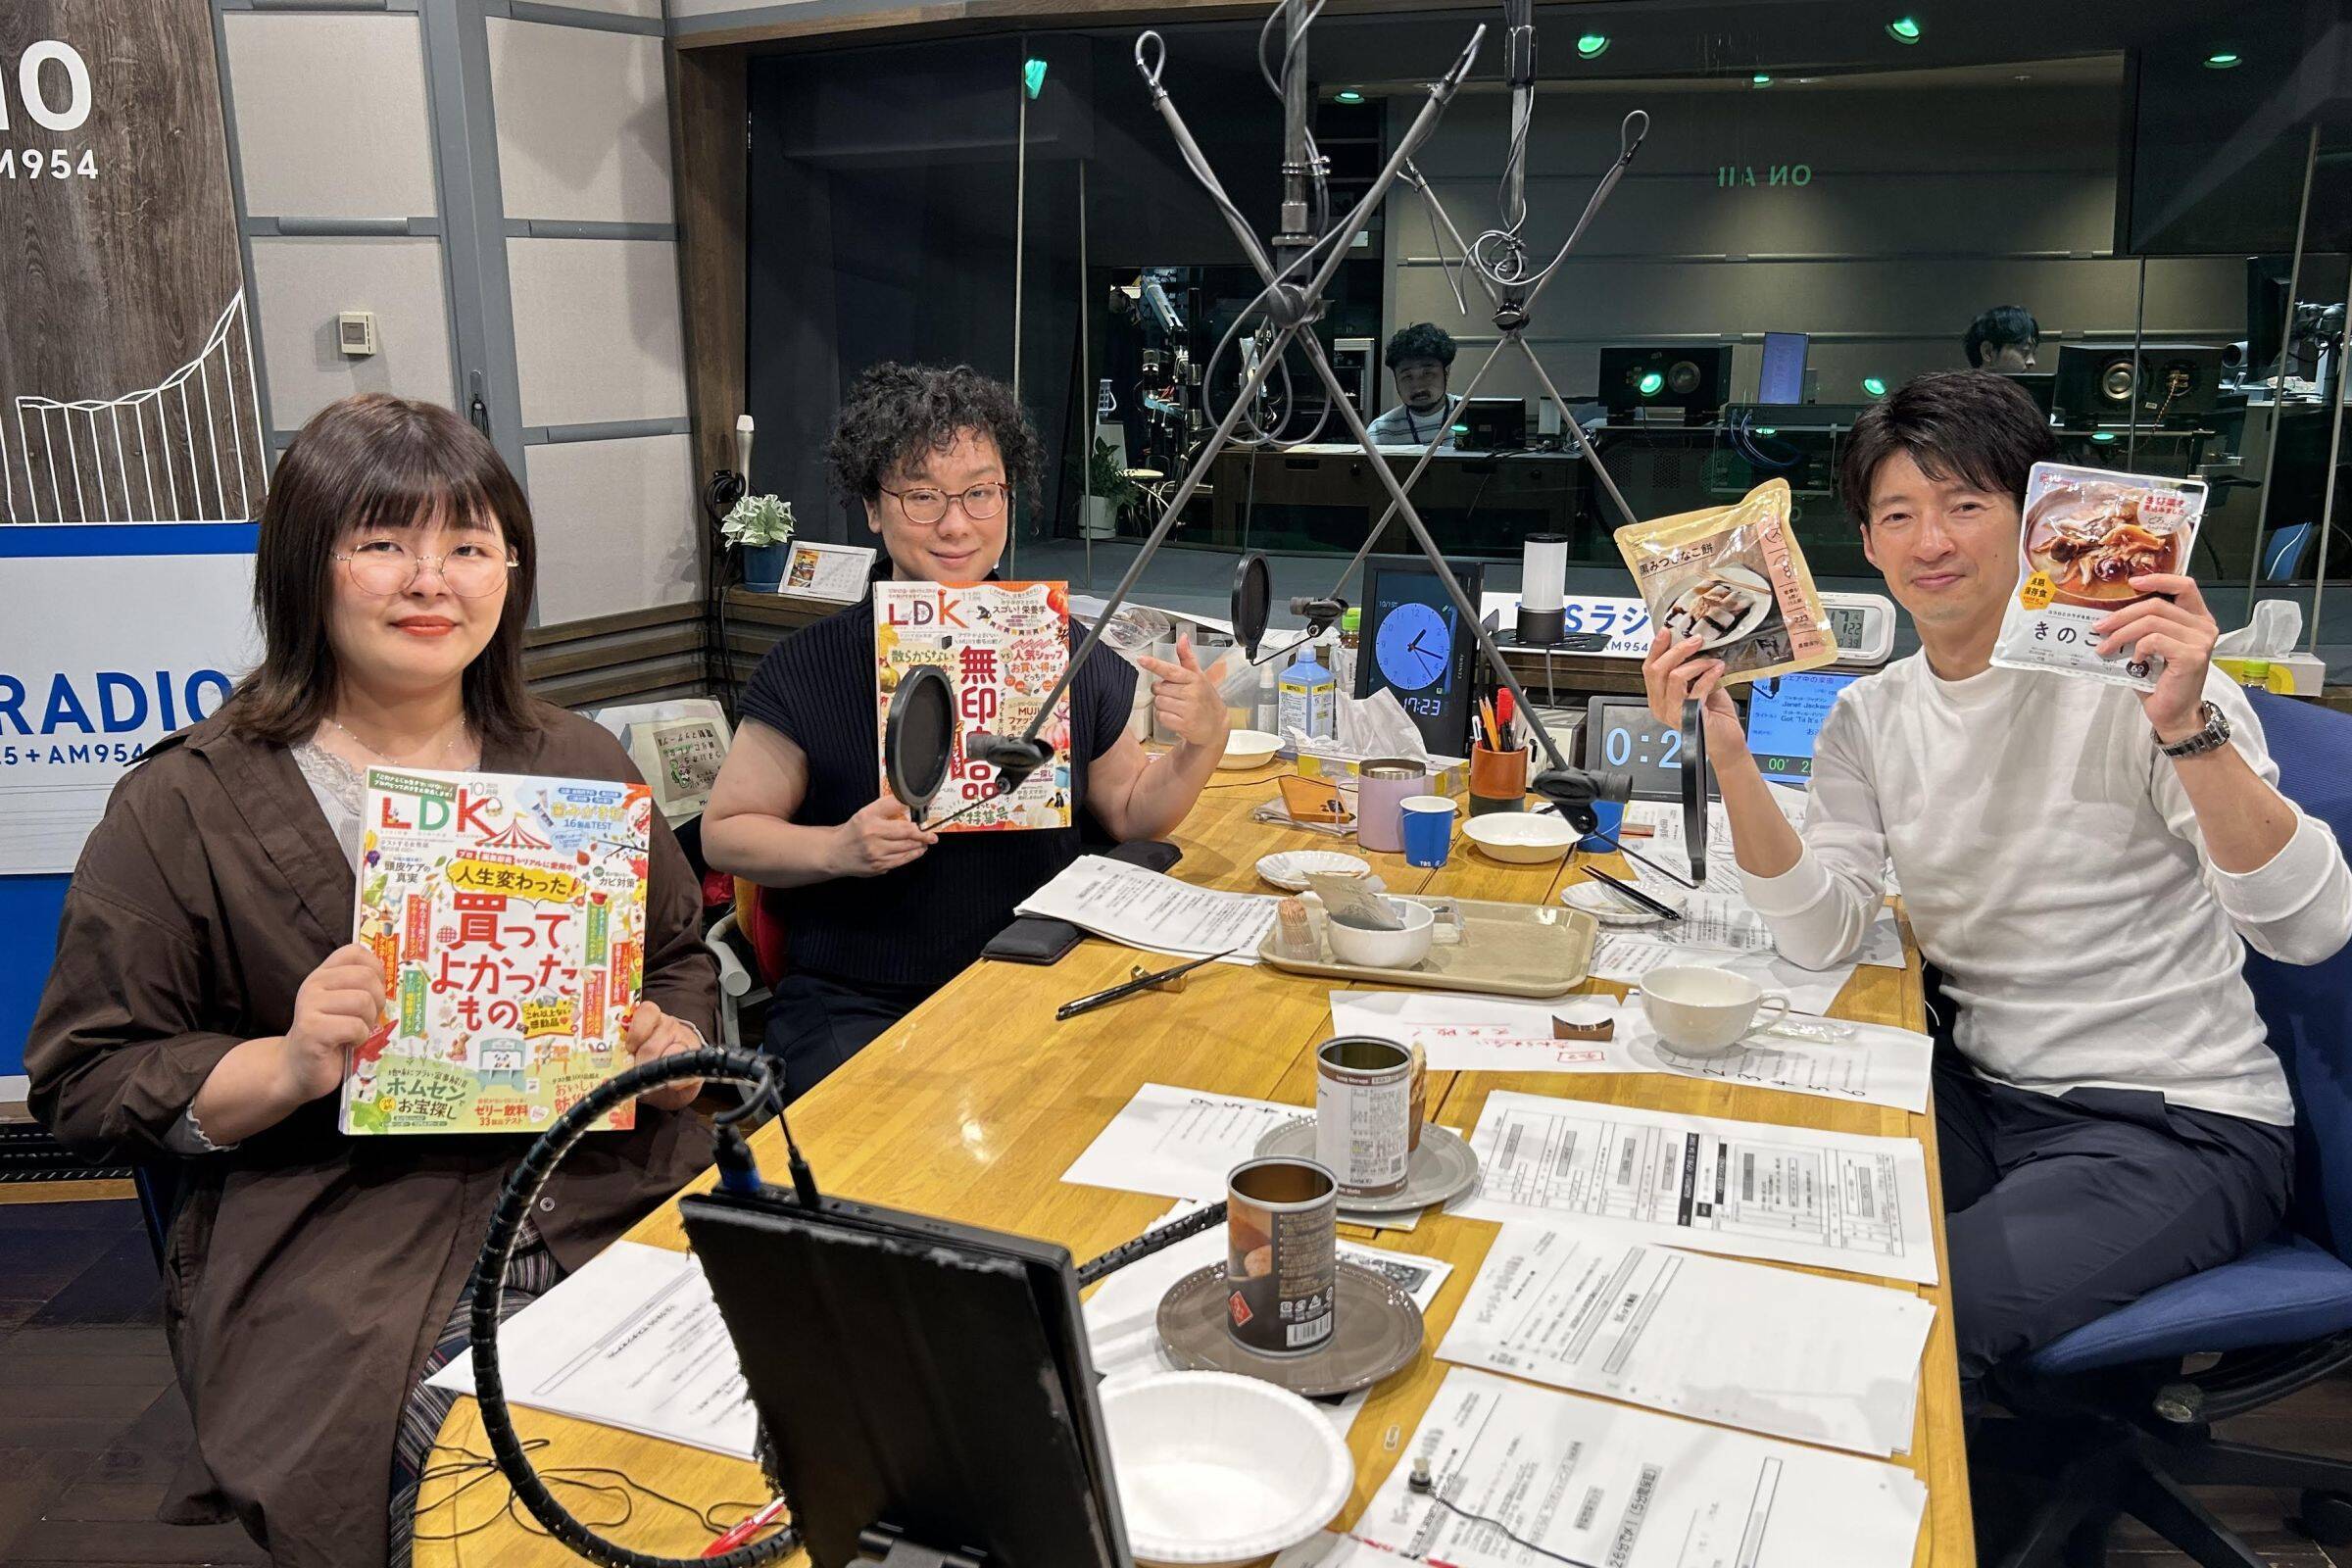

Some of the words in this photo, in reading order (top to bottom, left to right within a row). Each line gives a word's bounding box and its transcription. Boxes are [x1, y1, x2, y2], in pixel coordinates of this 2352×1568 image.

[888, 589, 969, 629] LDK
[1403, 697, 1442, 716] 17:23
[381, 788, 499, 839] LDK
[447, 893, 570, 952] 買って
[431, 951, 578, 996] よかった
[458, 996, 519, 1032] もの
[397, 1098, 458, 1120] お宝探し
[473, 1105, 529, 1117] ゼリー飲料
